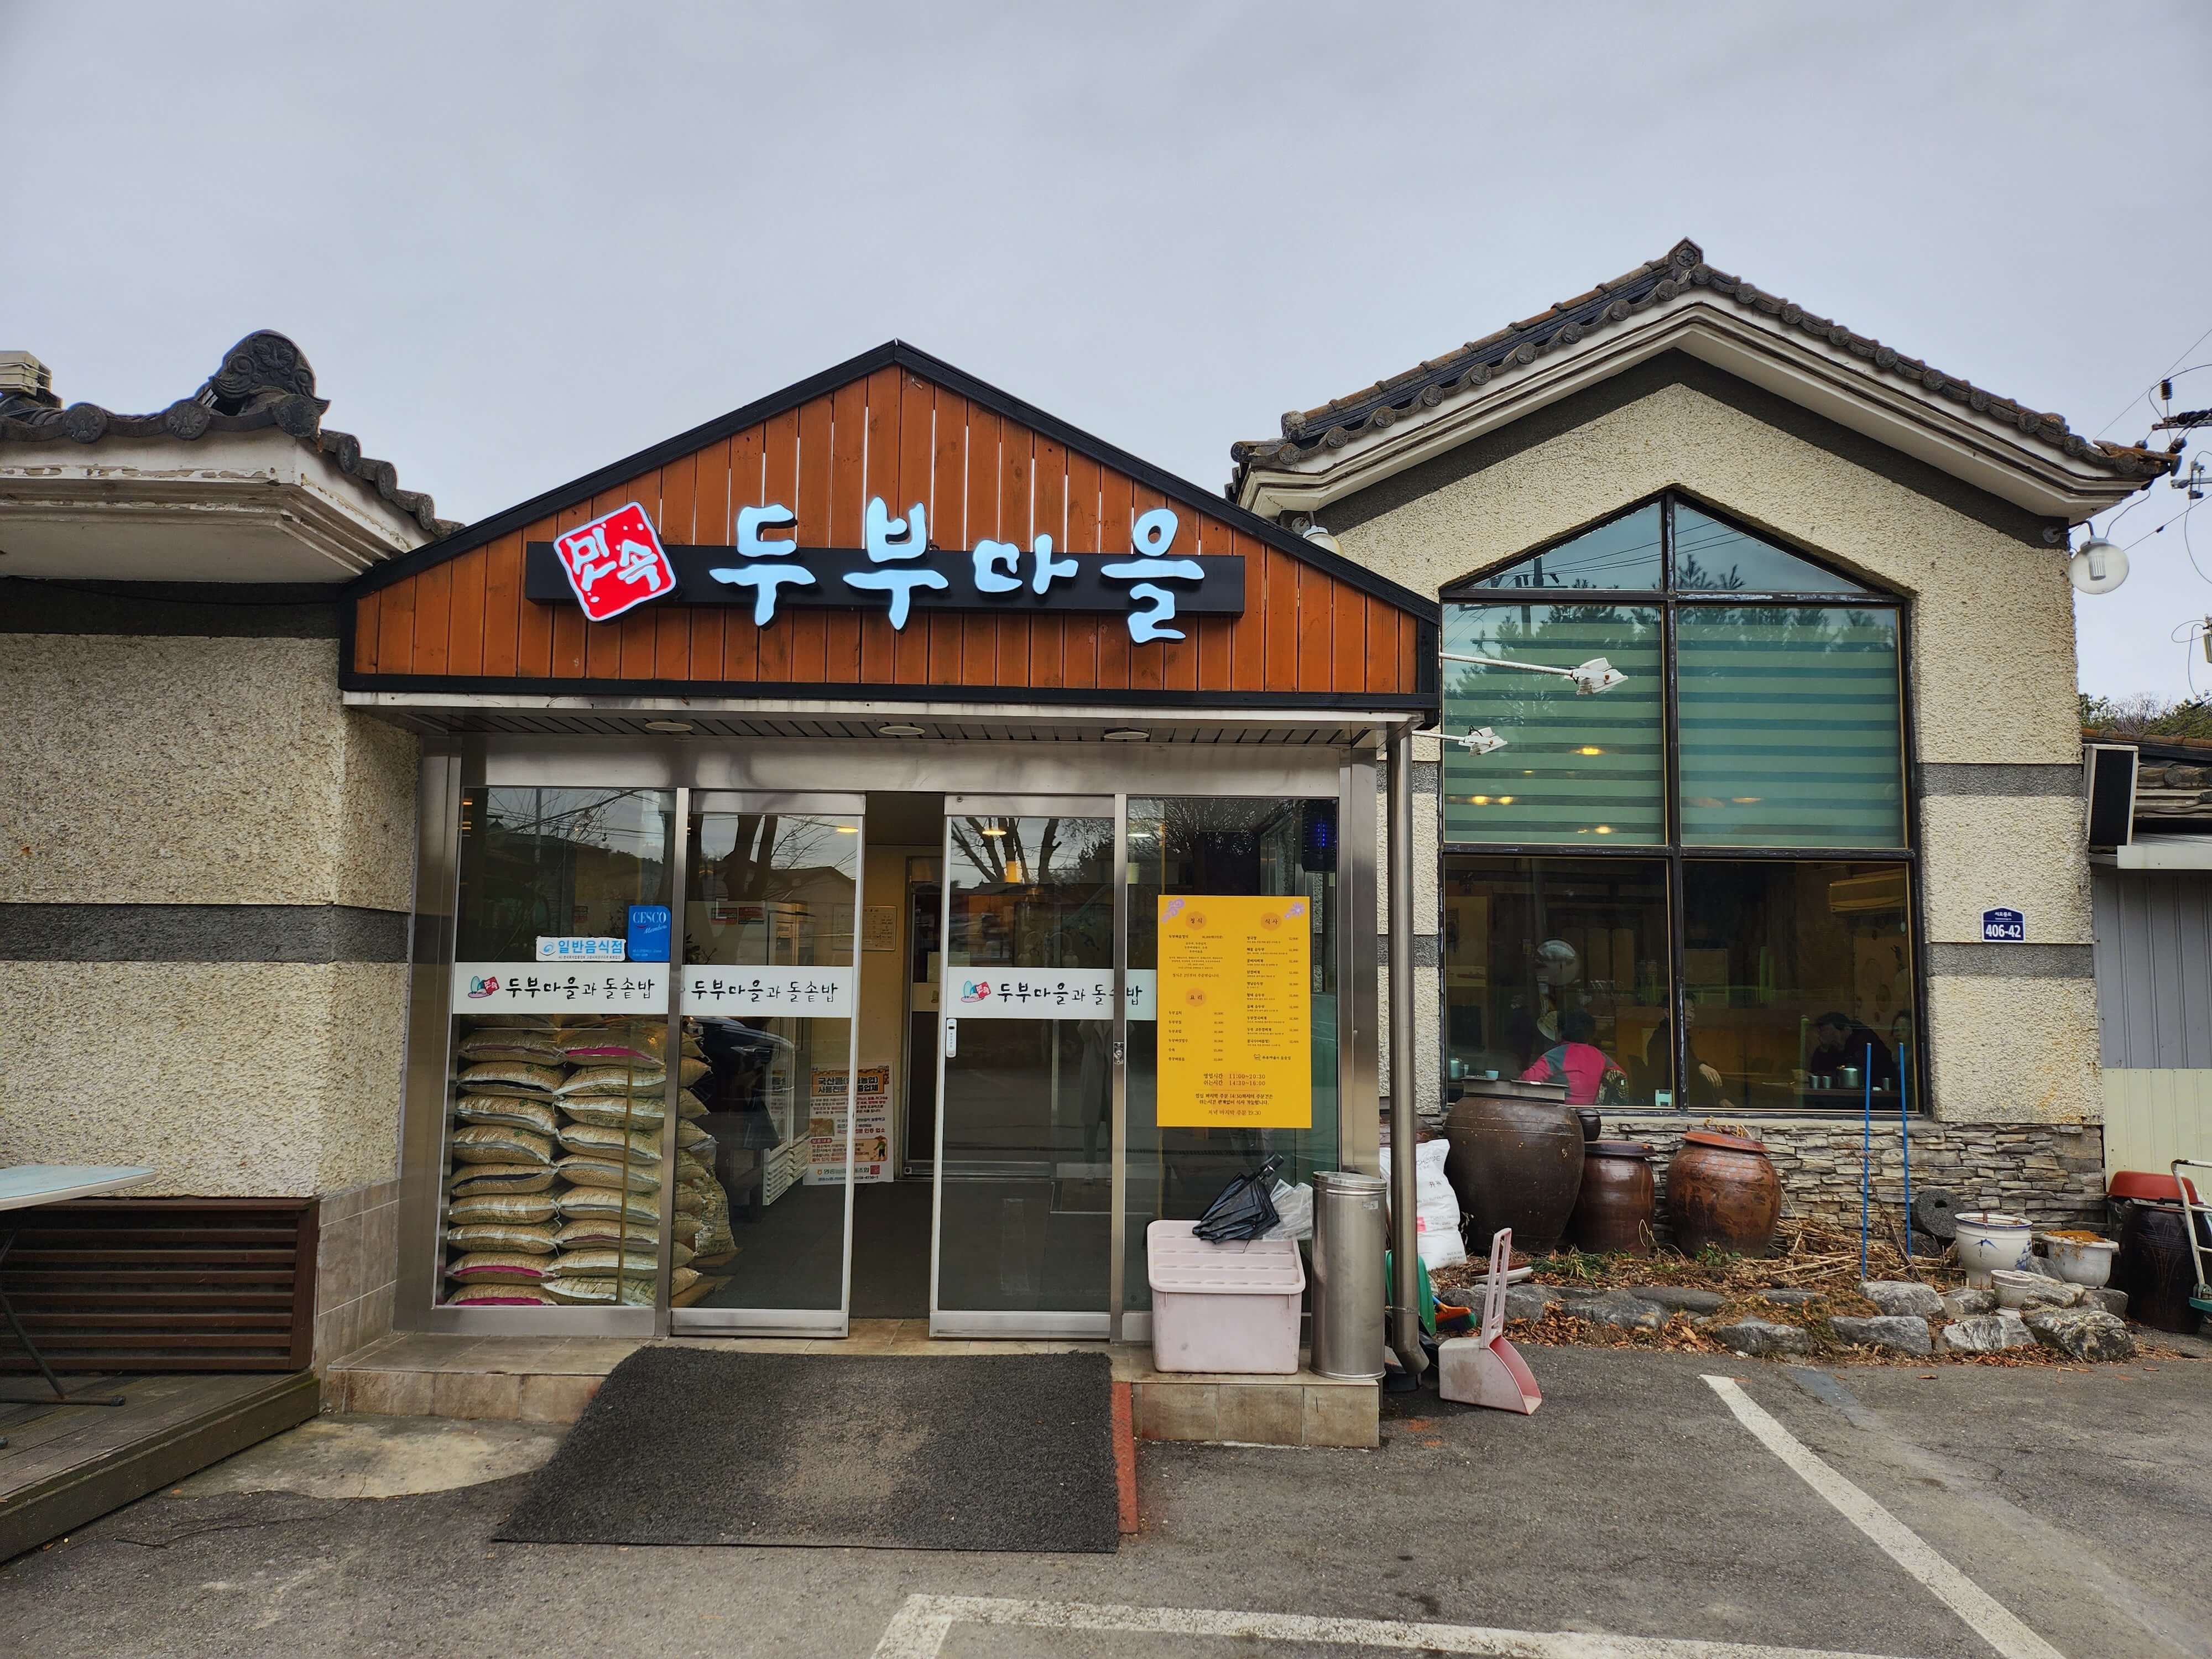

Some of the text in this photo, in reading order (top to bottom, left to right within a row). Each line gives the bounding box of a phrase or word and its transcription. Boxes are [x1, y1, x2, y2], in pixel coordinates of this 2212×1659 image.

[566, 495, 1206, 645] 민속 두부마을
[633, 911, 666, 924] CESCO
[1985, 924, 2021, 938] 406-42
[558, 939, 623, 954] 일반음식점
[505, 976, 655, 999] 두부마을과 돌솥밥
[691, 979, 838, 1003] 두부마을과 돌솥밥
[997, 982, 1143, 1006] 두부마을과 돌밥
